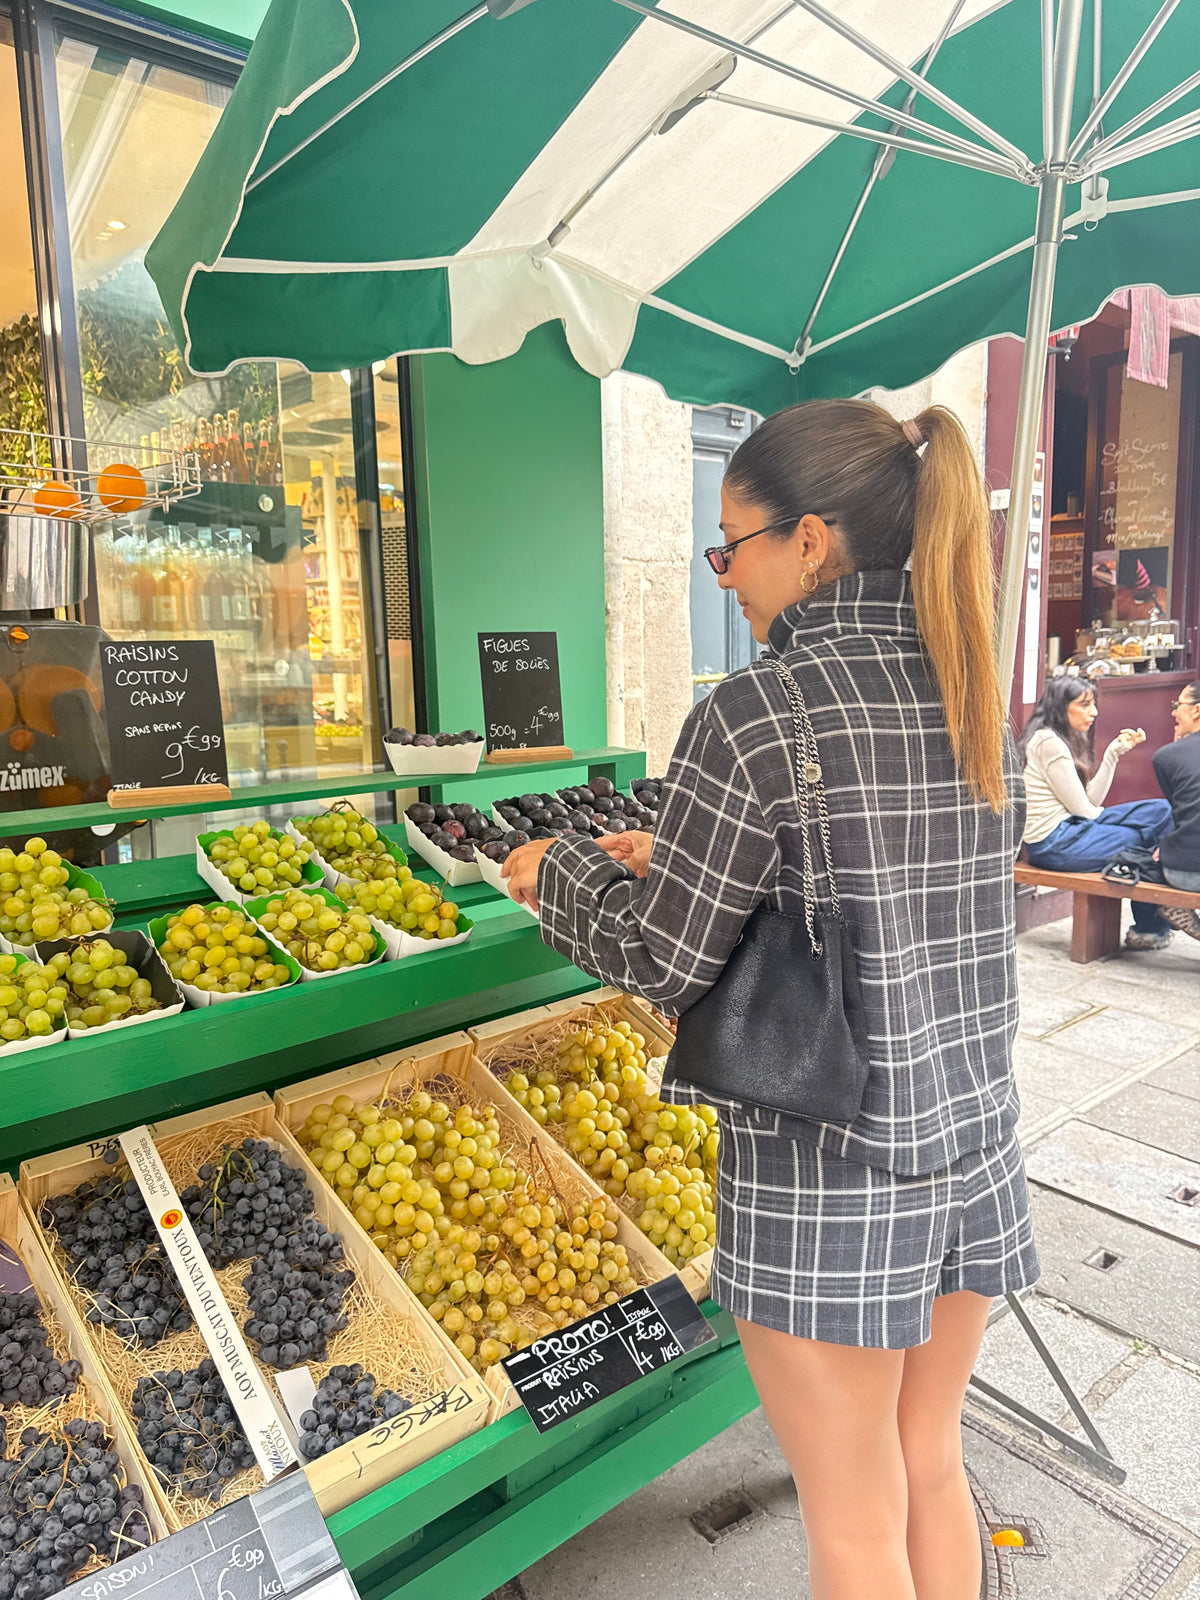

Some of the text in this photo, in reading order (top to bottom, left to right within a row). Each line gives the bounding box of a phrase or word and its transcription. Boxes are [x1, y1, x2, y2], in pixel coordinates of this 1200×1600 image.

[104, 645, 180, 664] RAISINS
[483, 638, 530, 653] FIGUES
[492, 660, 508, 673] DE
[115, 668, 189, 686] COTTON
[130, 690, 186, 707] CANDY
[124, 726, 151, 737] SANS
[489, 723, 517, 741] 500g
[132, 1147, 158, 1196] PRODUCTEUR
[159, 1180, 170, 1197] EARL
[172, 1228, 258, 1401] AOP MUSCAT DU VENTOUX
[542, 1349, 605, 1390] RAISINS
[537, 1381, 600, 1425] ITALIA
